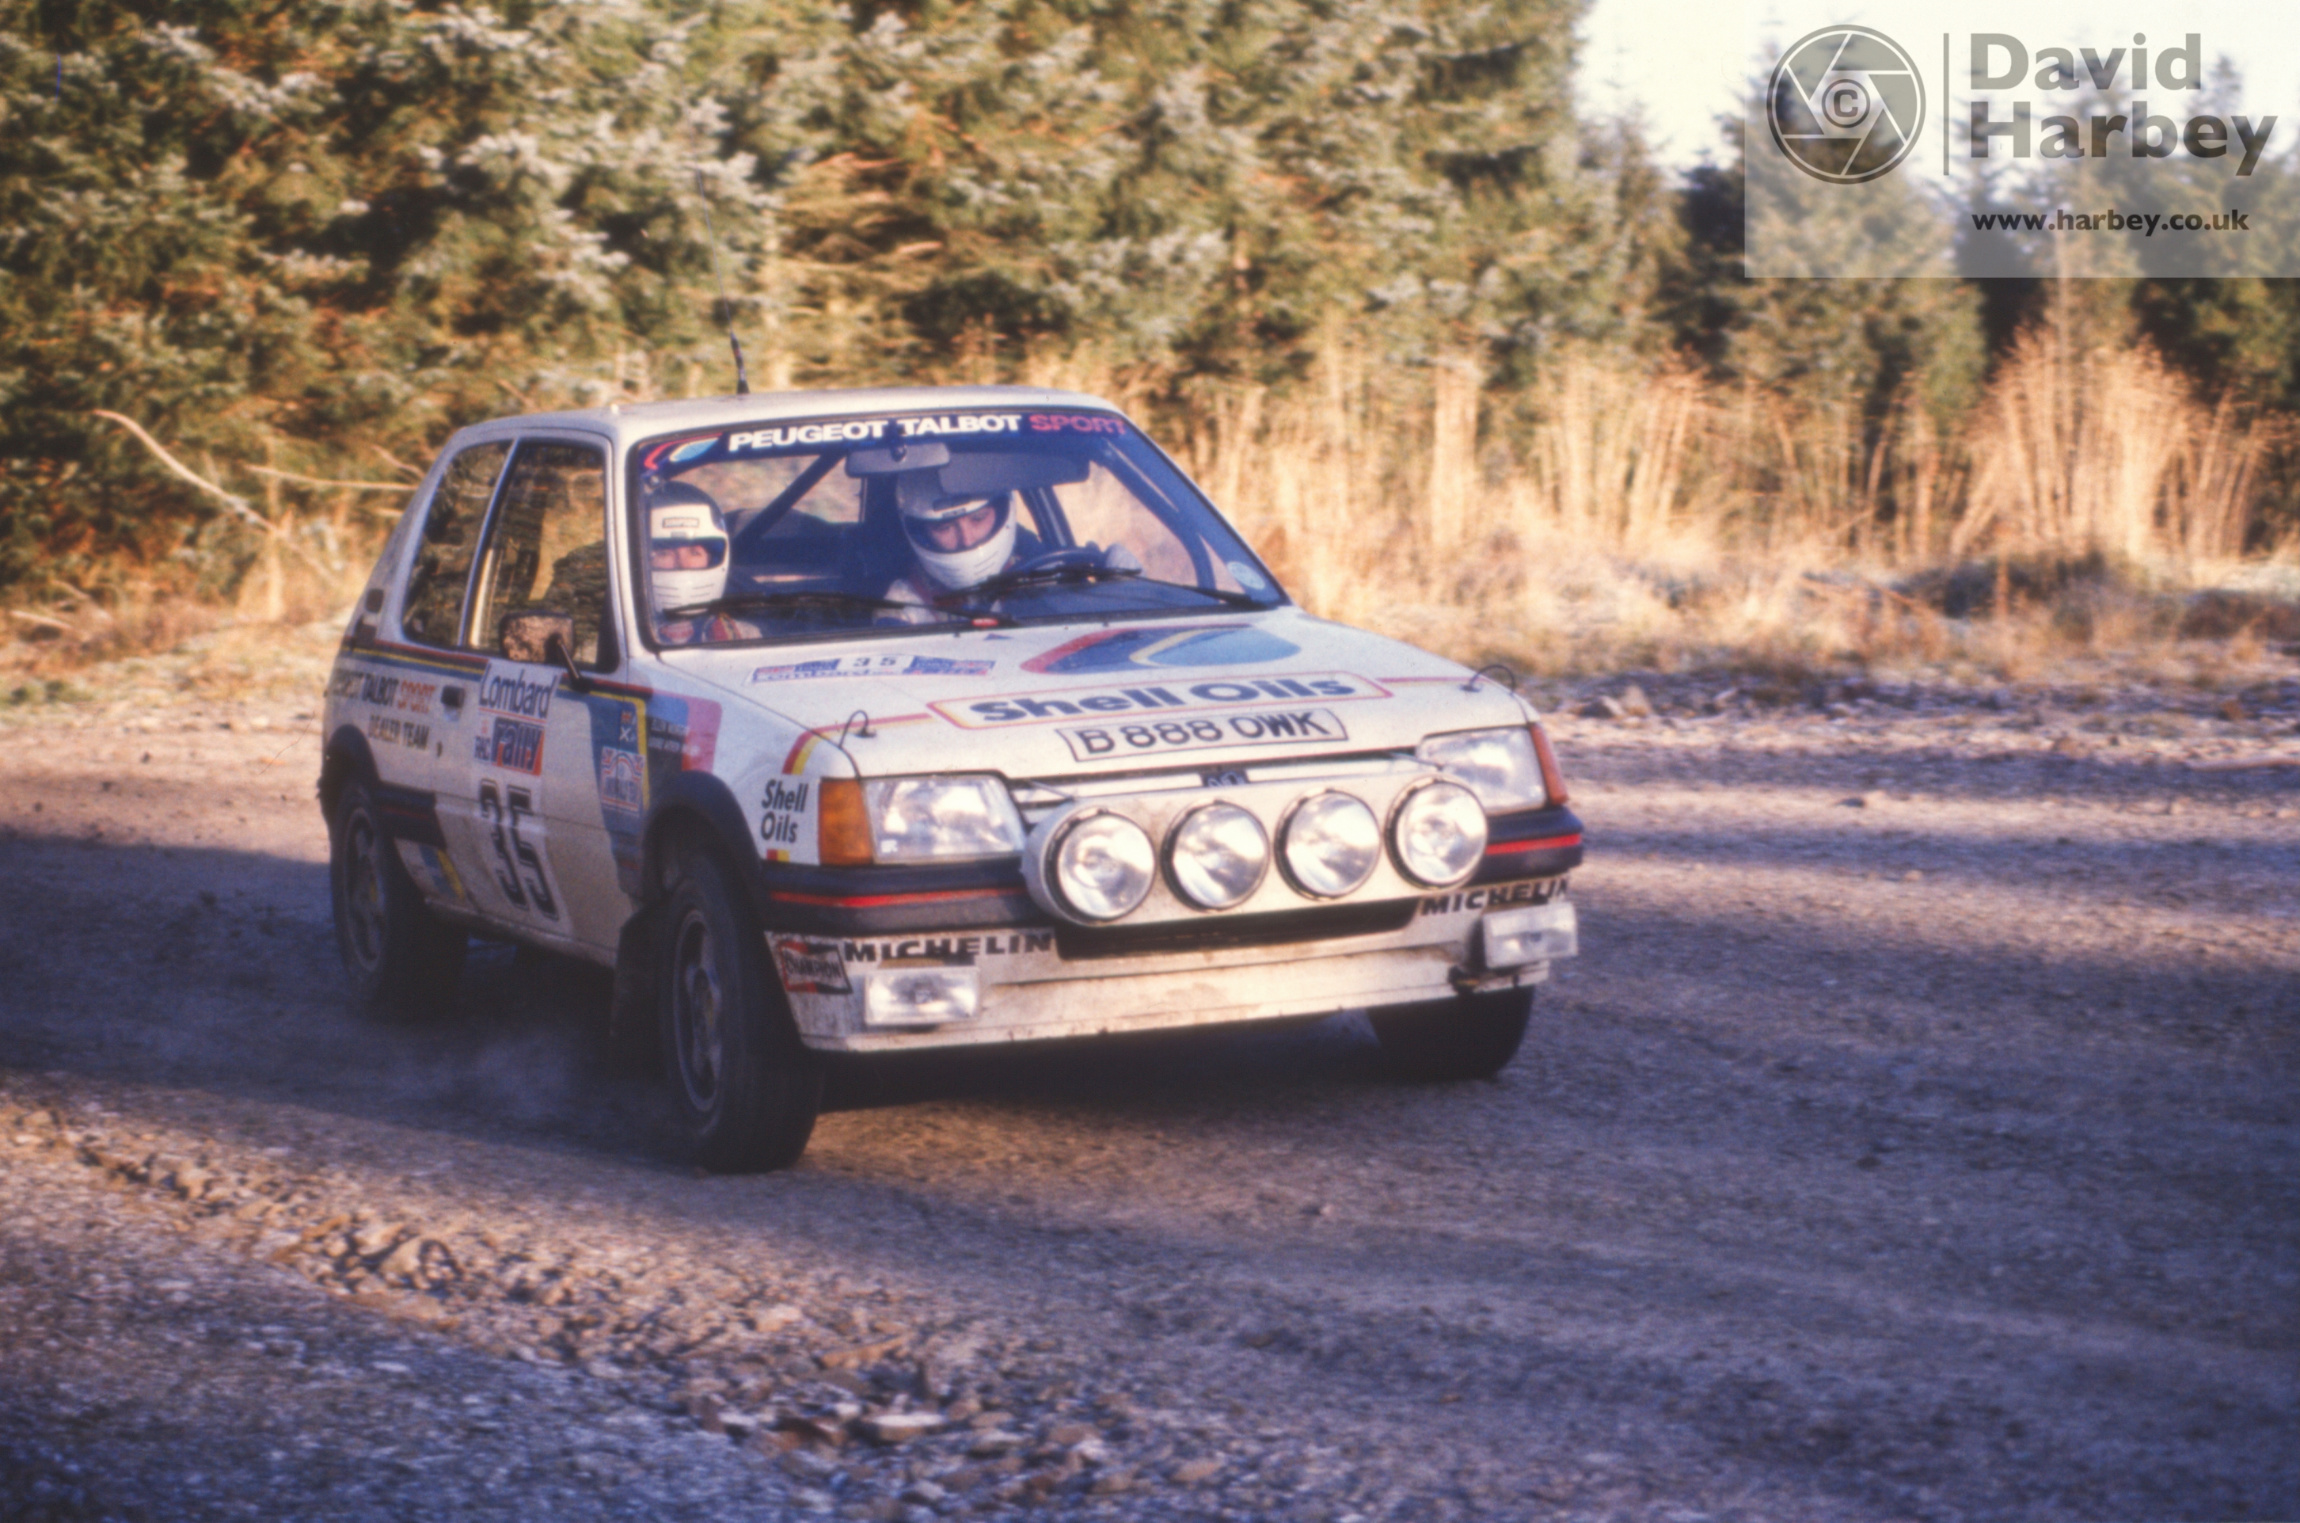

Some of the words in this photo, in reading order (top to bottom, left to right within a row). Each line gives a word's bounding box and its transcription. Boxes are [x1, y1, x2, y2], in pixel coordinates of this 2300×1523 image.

[728, 420, 888, 452] PEUGEOT
[896, 414, 1022, 437] TALBOT
[1029, 413, 1126, 435] SPORT
[480, 663, 557, 719] Lombard
[969, 686, 1186, 721] Shell
[1189, 678, 1355, 701] Oils
[403, 721, 430, 750] TEAM
[1228, 711, 1331, 739] OWK
[761, 779, 808, 813] Shell
[760, 811, 798, 843] Oils
[479, 778, 560, 922] 35
[1421, 880, 1568, 915] MICHELIN
[844, 934, 1052, 962] MICHELIN
